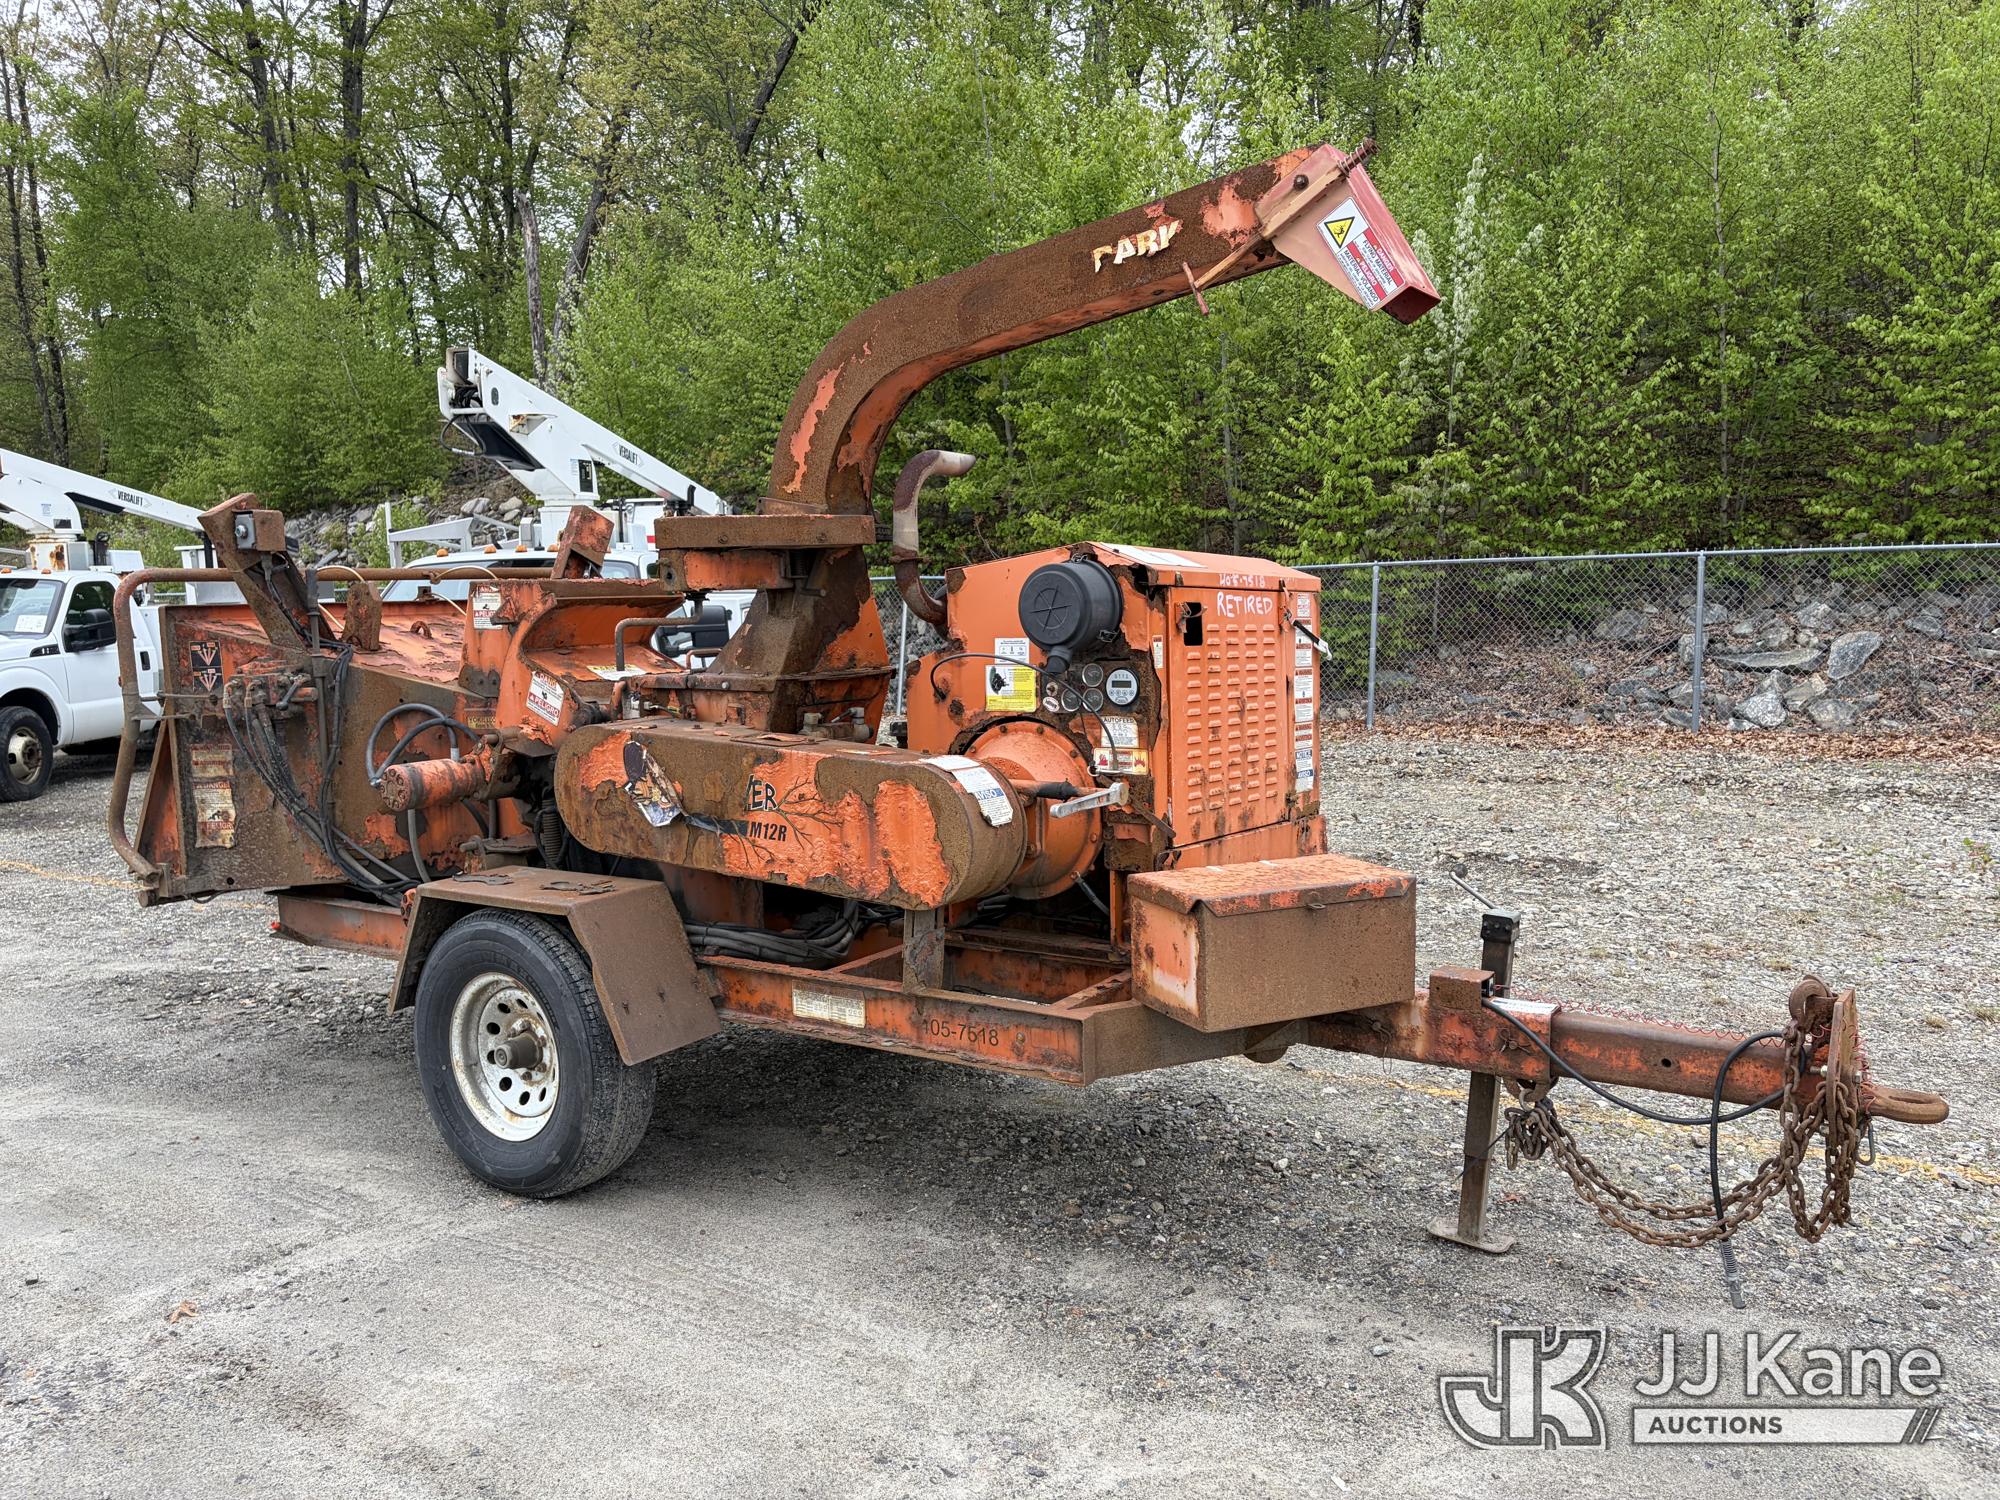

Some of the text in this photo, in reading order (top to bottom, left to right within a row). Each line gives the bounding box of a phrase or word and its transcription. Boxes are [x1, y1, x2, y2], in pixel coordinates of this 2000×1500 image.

[1363, 240, 1393, 285] FLYING MATERIAL
[1376, 248, 1394, 272] DANGER
[1344, 250, 1362, 276] MATERIAL
[1360, 276, 1379, 302] VOLANDO
[1359, 261, 1377, 286] PELIGRO
[117, 490, 144, 507] VERSALIFT
[1217, 592, 1273, 617] RETIRED
[534, 698, 559, 717] PELIGRO
[976, 790, 997, 801] AVISO
[750, 821, 787, 842] M12R
